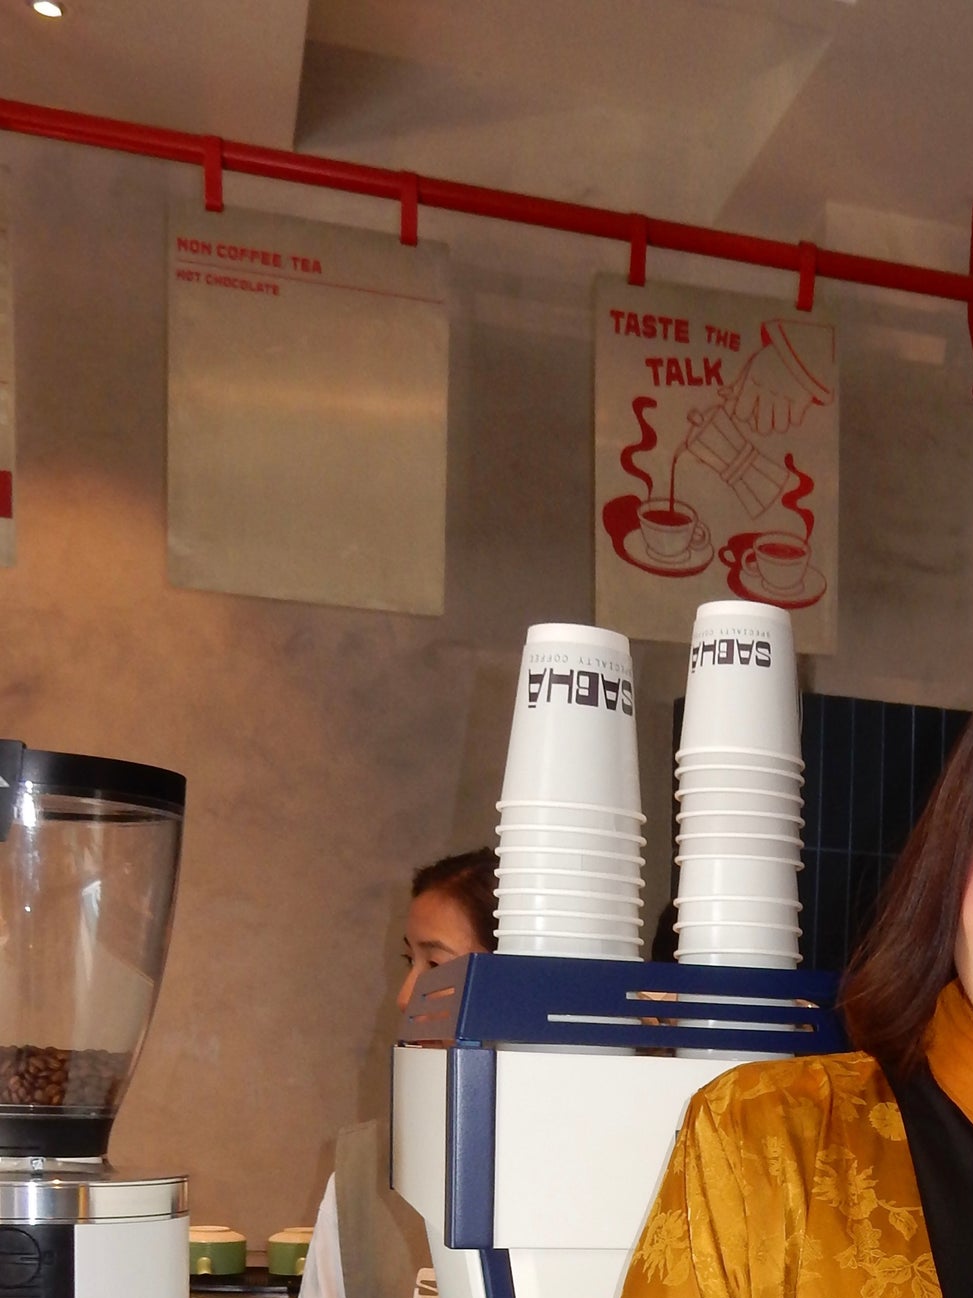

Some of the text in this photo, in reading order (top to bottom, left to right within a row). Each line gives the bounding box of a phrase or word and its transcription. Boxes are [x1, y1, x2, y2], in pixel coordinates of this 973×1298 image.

[176, 237, 323, 274] NON COFFEE TEA
[176, 269, 280, 296] HOT CHOCOLATE
[609, 309, 741, 352] TASTE THE
[645, 356, 725, 387] TALK
